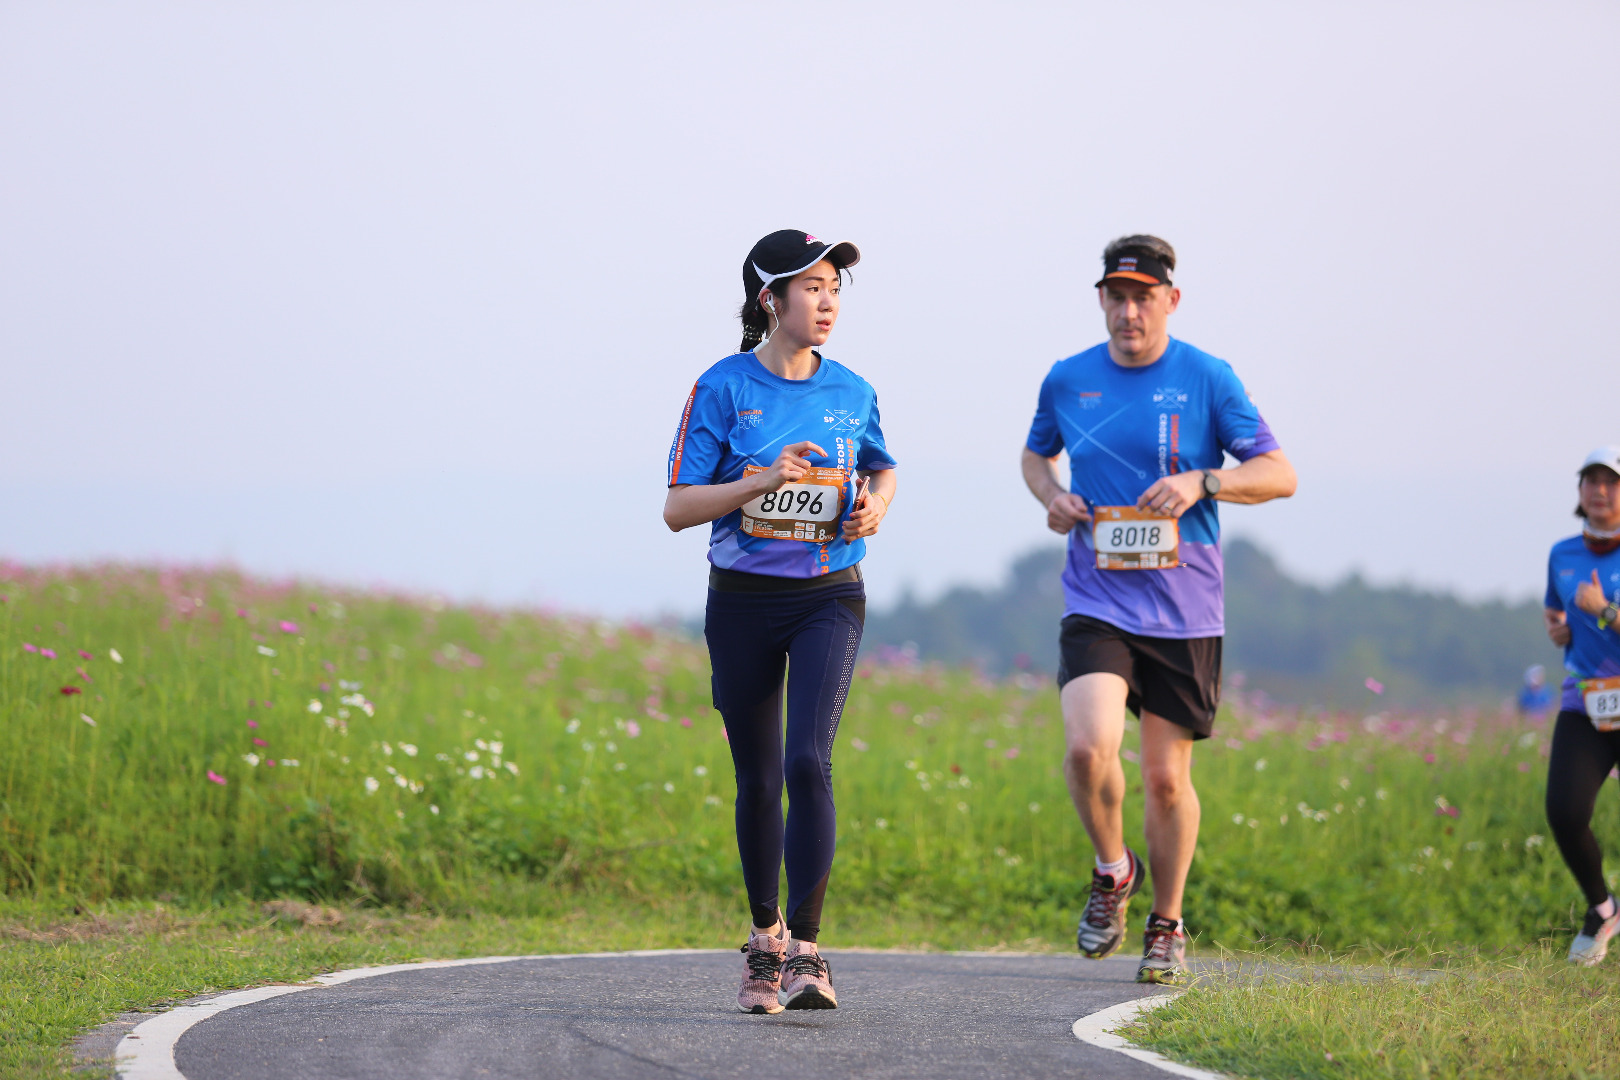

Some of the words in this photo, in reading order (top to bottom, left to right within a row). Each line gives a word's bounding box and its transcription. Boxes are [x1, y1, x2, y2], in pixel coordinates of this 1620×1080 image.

[848, 418, 860, 426] XC
[835, 437, 845, 471] CROSS
[843, 438, 855, 484] SINGHA
[760, 490, 824, 515] 8096
[1111, 526, 1161, 546] 8018
